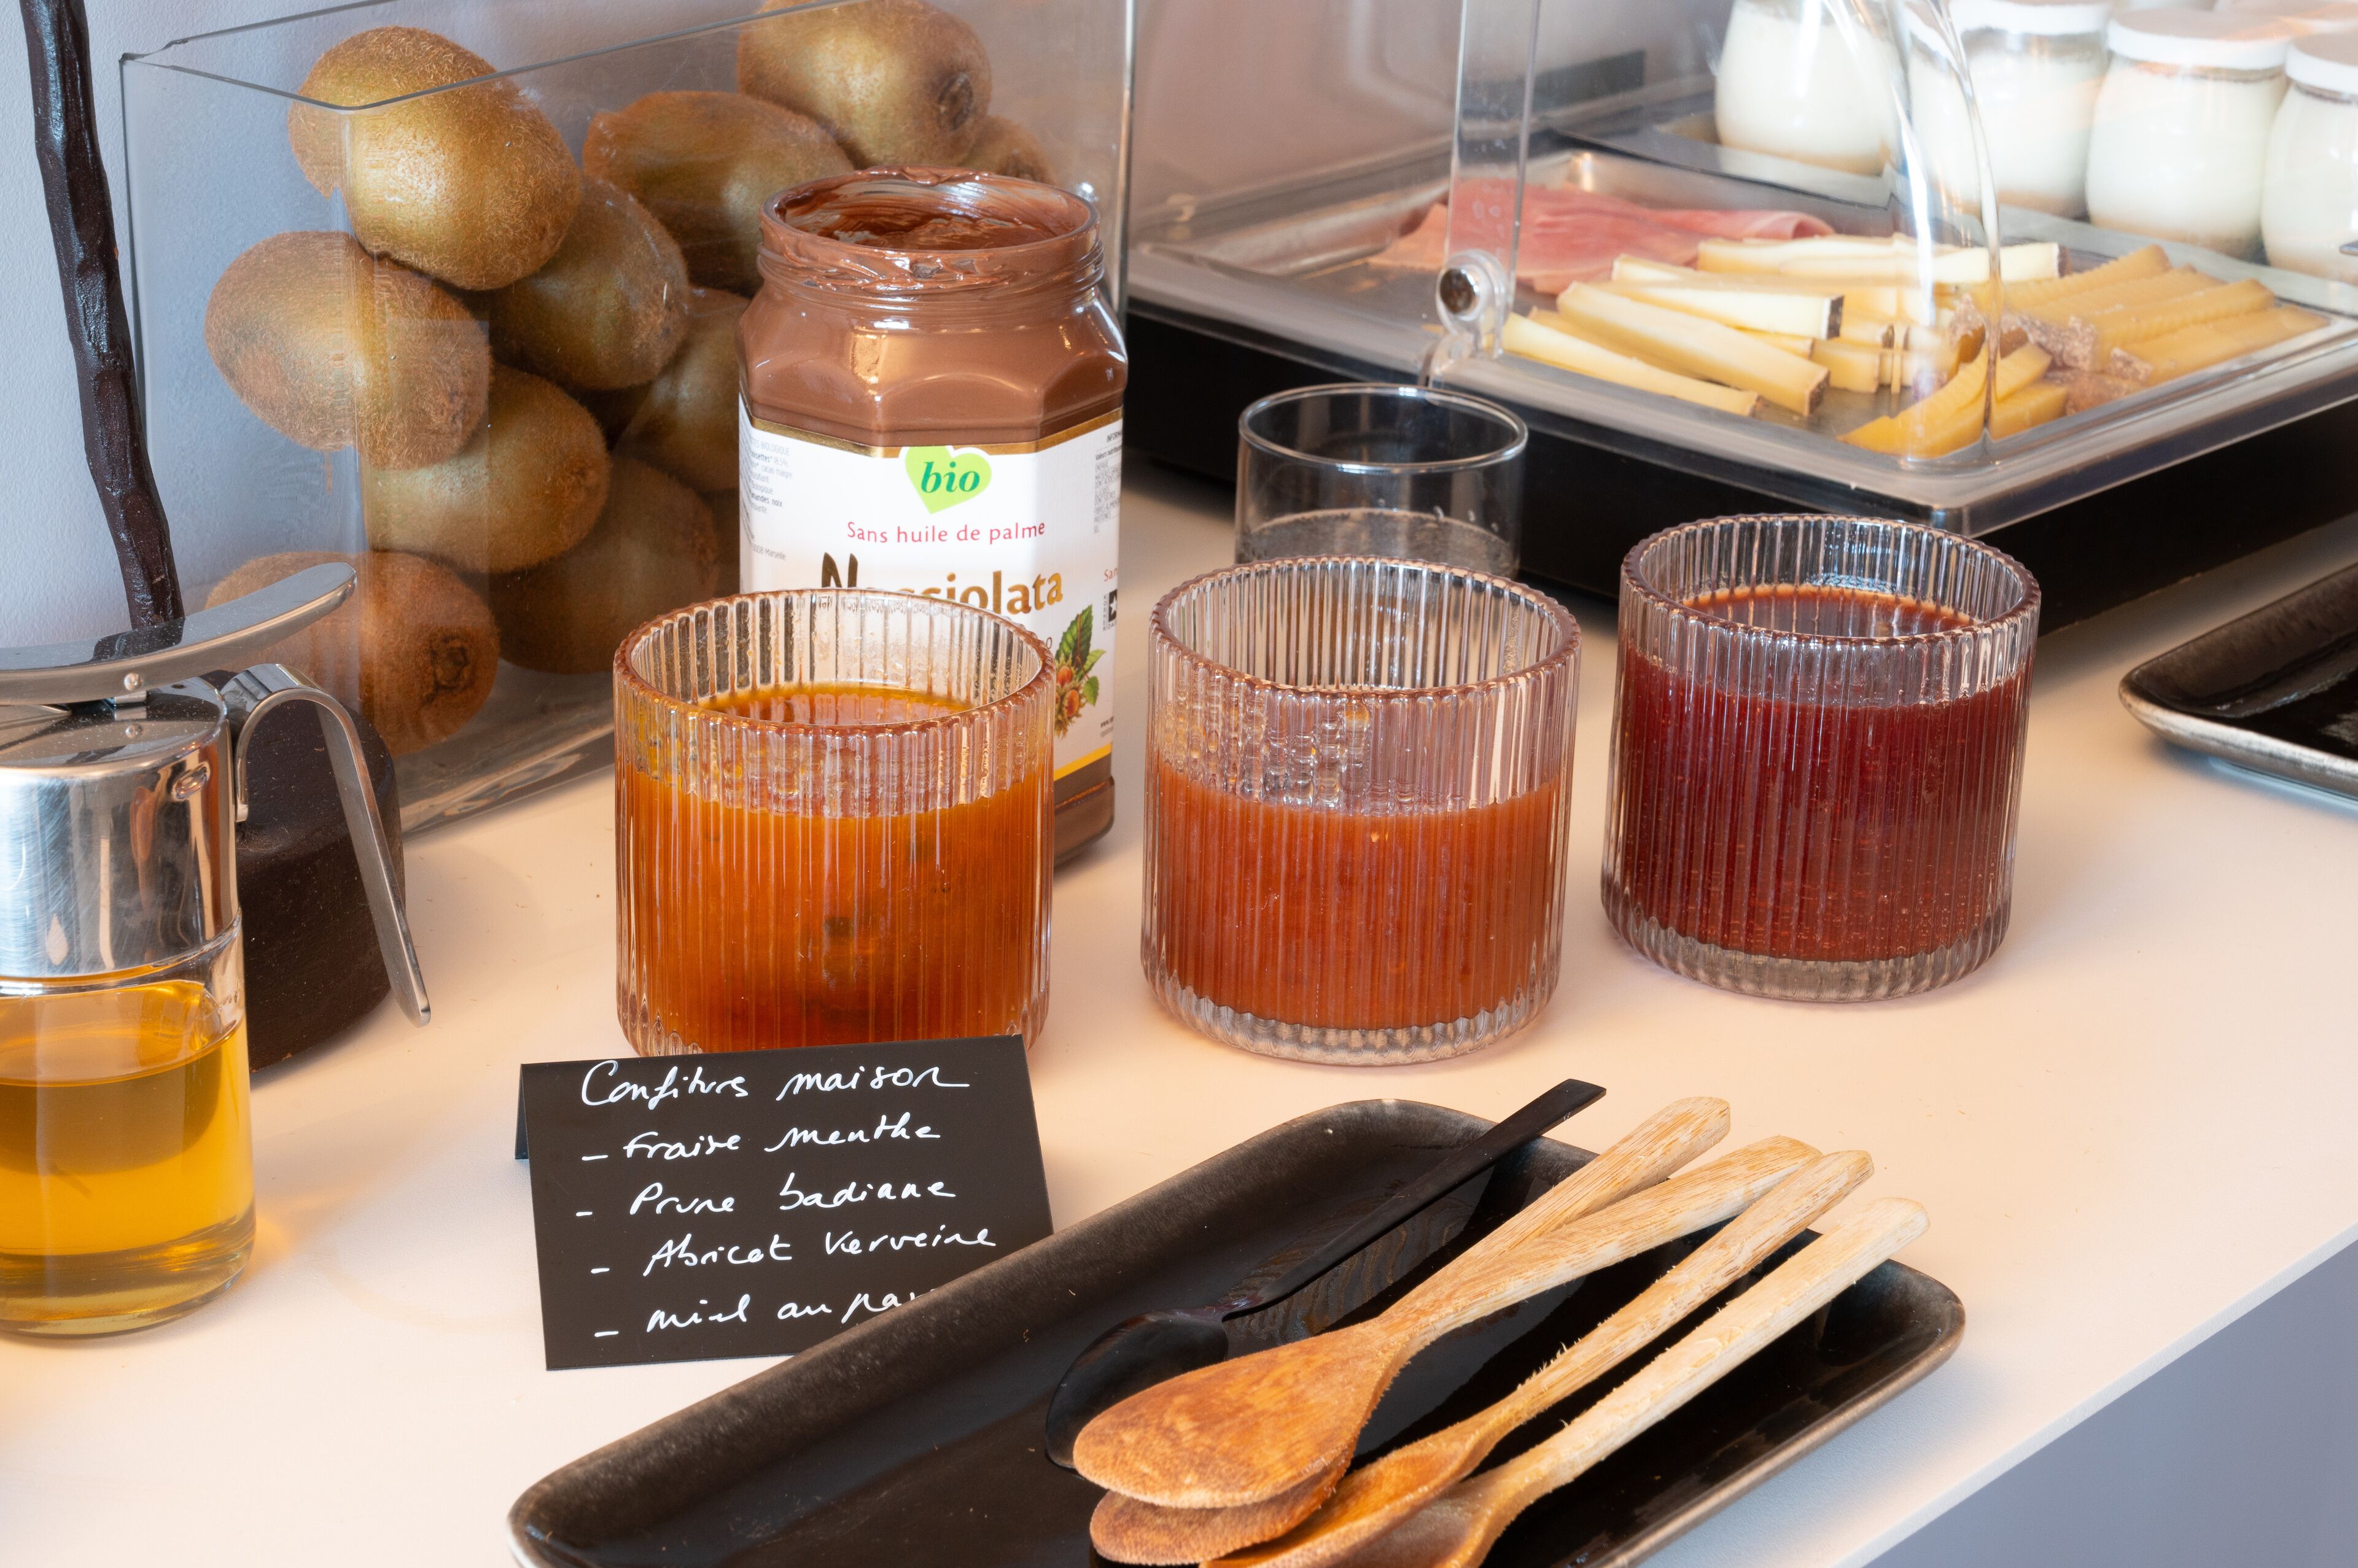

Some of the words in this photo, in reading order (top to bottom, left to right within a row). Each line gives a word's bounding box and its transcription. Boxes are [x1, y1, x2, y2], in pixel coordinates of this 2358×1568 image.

[920, 460, 981, 494] bio
[847, 521, 888, 543] Sans
[897, 526, 948, 543] huile
[956, 524, 981, 541] de
[989, 522, 1045, 545] palme
[776, 1066, 970, 1101] maison
[764, 1111, 941, 1152] menthe
[629, 1182, 735, 1215] Prune
[779, 1172, 956, 1211] badiane
[642, 1233, 793, 1277] Abricot
[646, 1294, 750, 1333] miel
